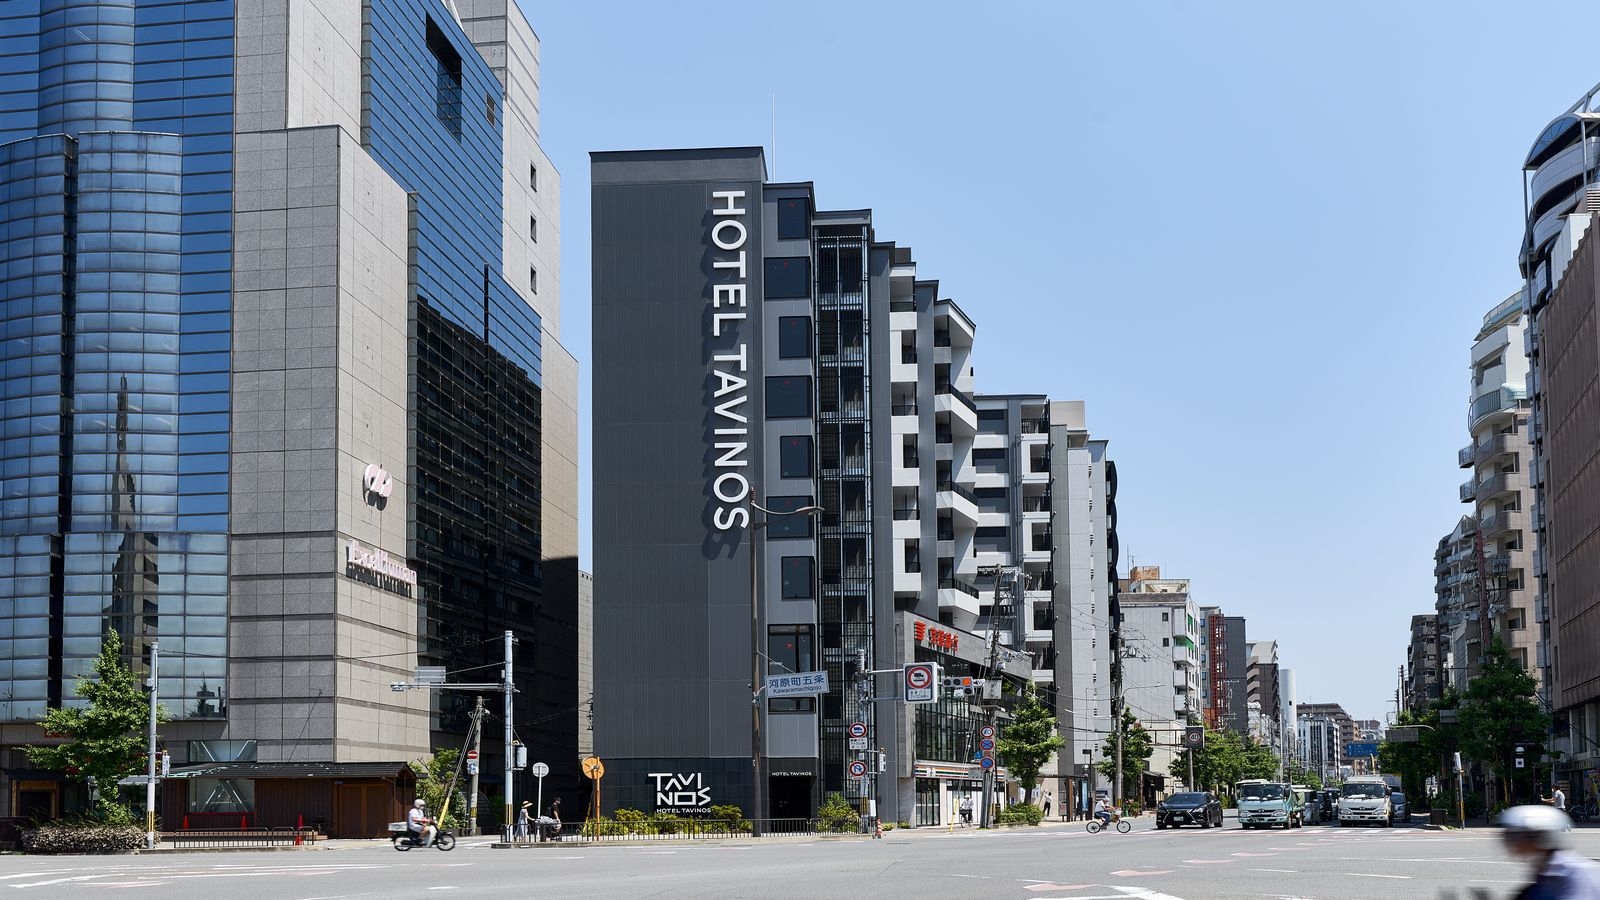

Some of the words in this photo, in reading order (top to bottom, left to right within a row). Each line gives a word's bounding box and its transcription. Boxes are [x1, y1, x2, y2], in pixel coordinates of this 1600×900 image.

[711, 190, 748, 337] HOTEL
[713, 343, 750, 531] TAVINOS
[768, 674, 824, 688] 河原町五条
[648, 772, 702, 791] TAVI
[656, 786, 712, 807] NOS
